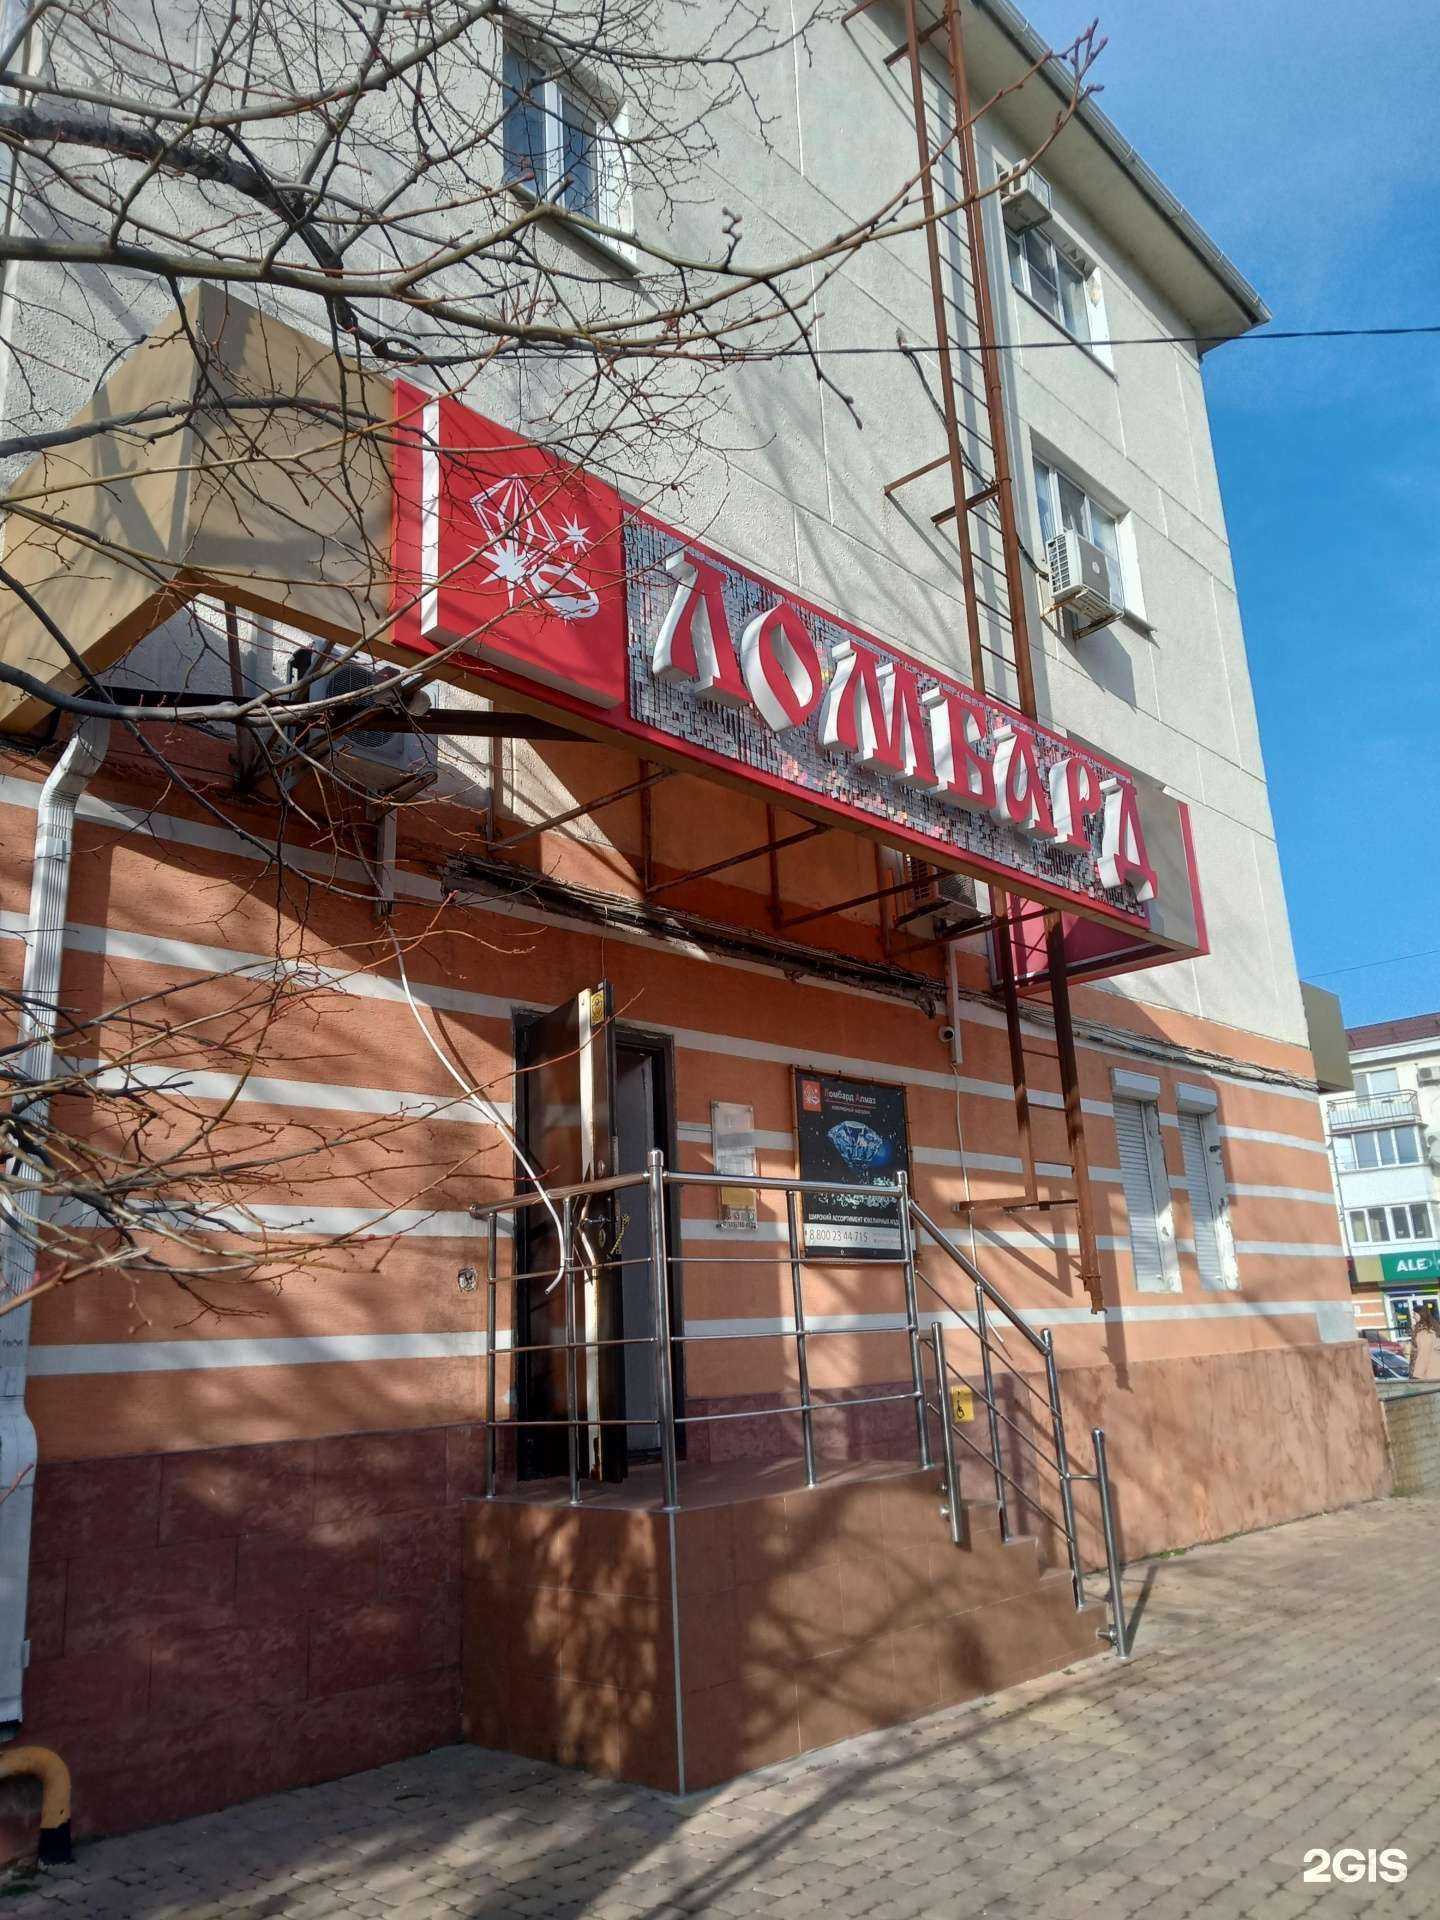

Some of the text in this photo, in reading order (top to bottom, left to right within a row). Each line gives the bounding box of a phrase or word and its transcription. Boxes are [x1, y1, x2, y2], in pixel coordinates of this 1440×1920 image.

[652, 550, 1159, 902] ЛОМБАРД
[809, 1229, 815, 1240] 8
[816, 1229, 831, 1241] 800
[833, 1230, 842, 1242] 23
